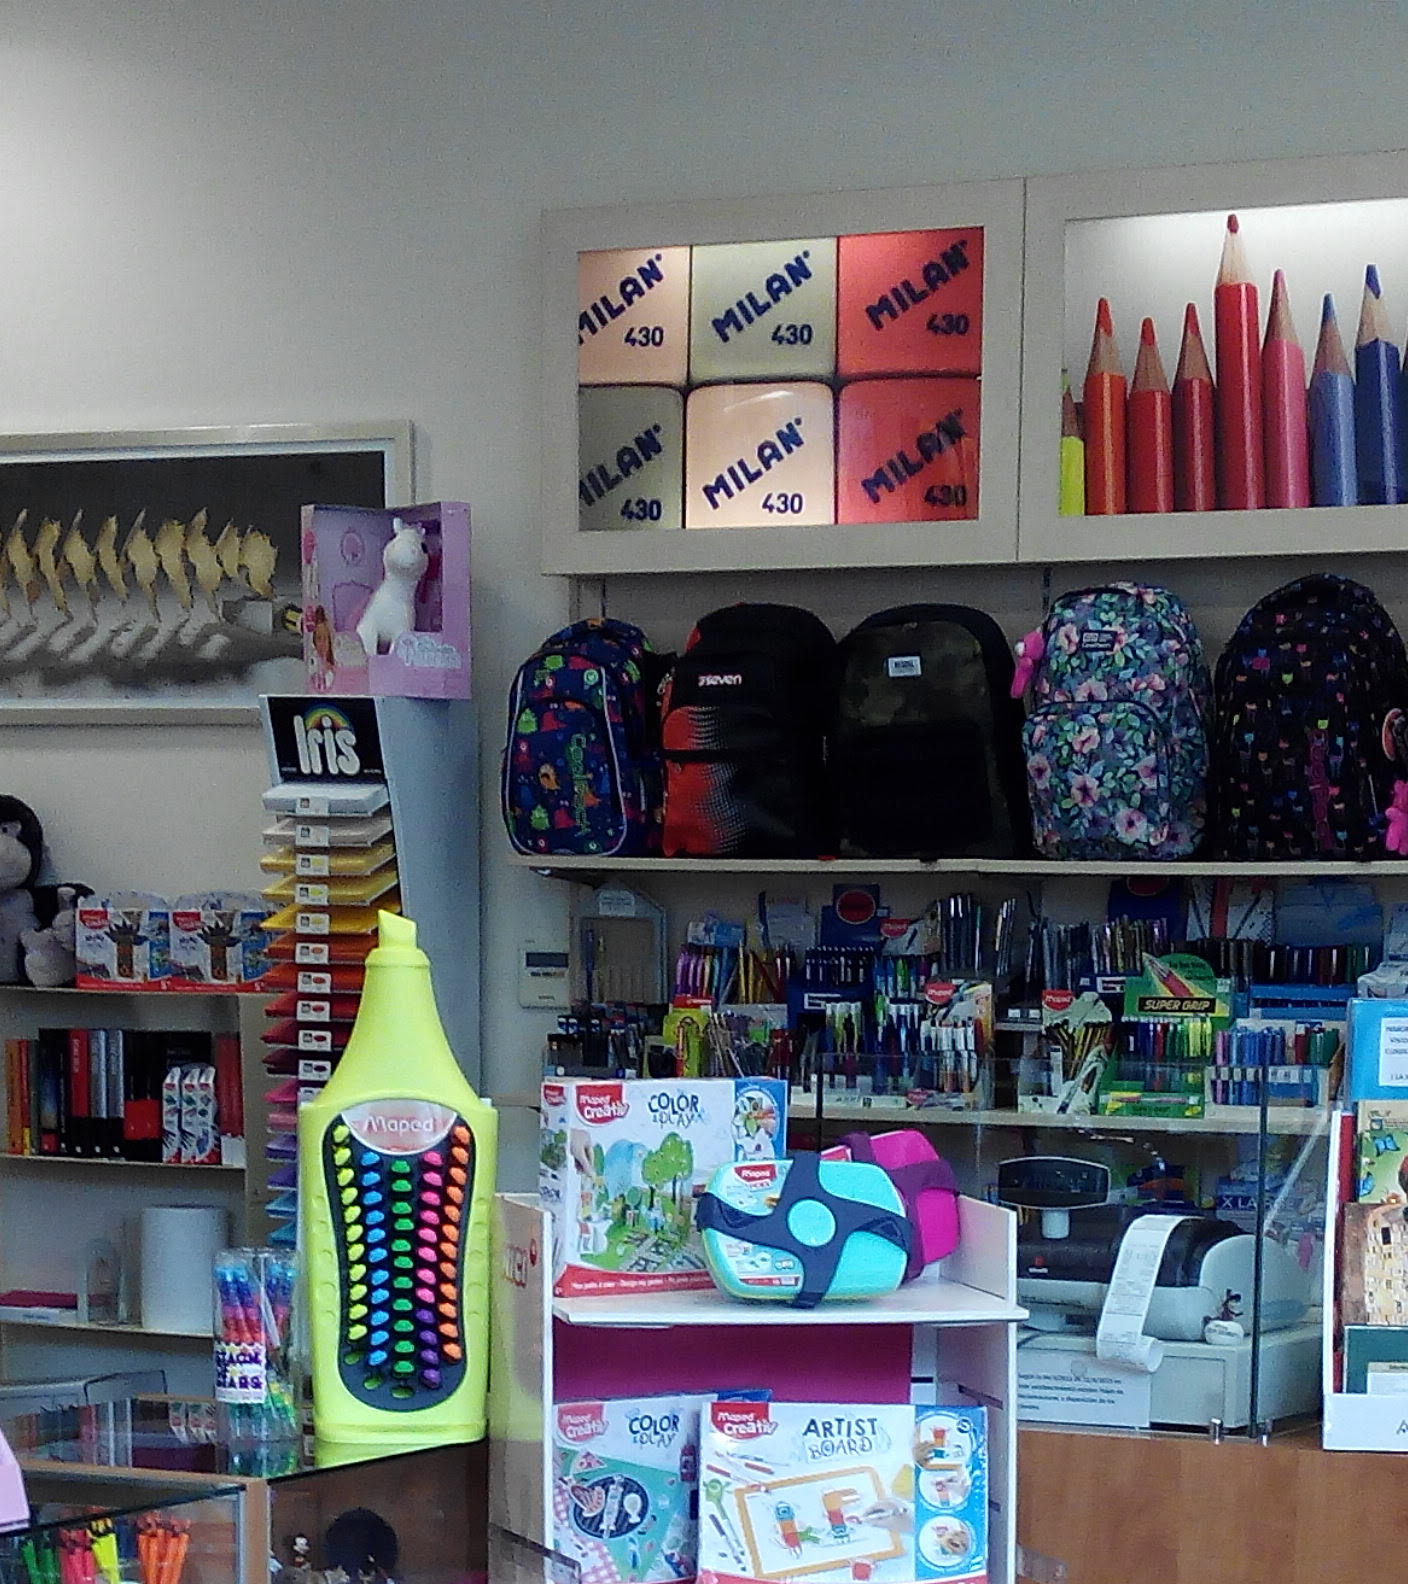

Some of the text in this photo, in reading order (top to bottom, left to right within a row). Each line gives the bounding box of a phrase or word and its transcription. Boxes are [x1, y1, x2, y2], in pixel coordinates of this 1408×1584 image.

[865, 240, 971, 331] MILAN
[578, 255, 664, 345] MILAN
[712, 252, 814, 344] MILAN
[771, 323, 814, 346] 430
[926, 313, 970, 336] 430
[624, 326, 665, 348] 430
[703, 418, 803, 509] MILAN
[861, 409, 967, 503] MILAN
[762, 492, 804, 515] 430
[923, 484, 968, 507] 430
[620, 499, 663, 522] 430
[293, 714, 361, 775] Iris
[1144, 999, 1211, 1012] SUPER GRIP
[648, 1091, 701, 1116] COLOR
[363, 1114, 435, 1134] Maped
[629, 1413, 680, 1435] COLOR
[717, 1411, 755, 1423] Maped
[802, 1417, 879, 1438] ARTIST
[808, 1436, 873, 1460] BOARD
